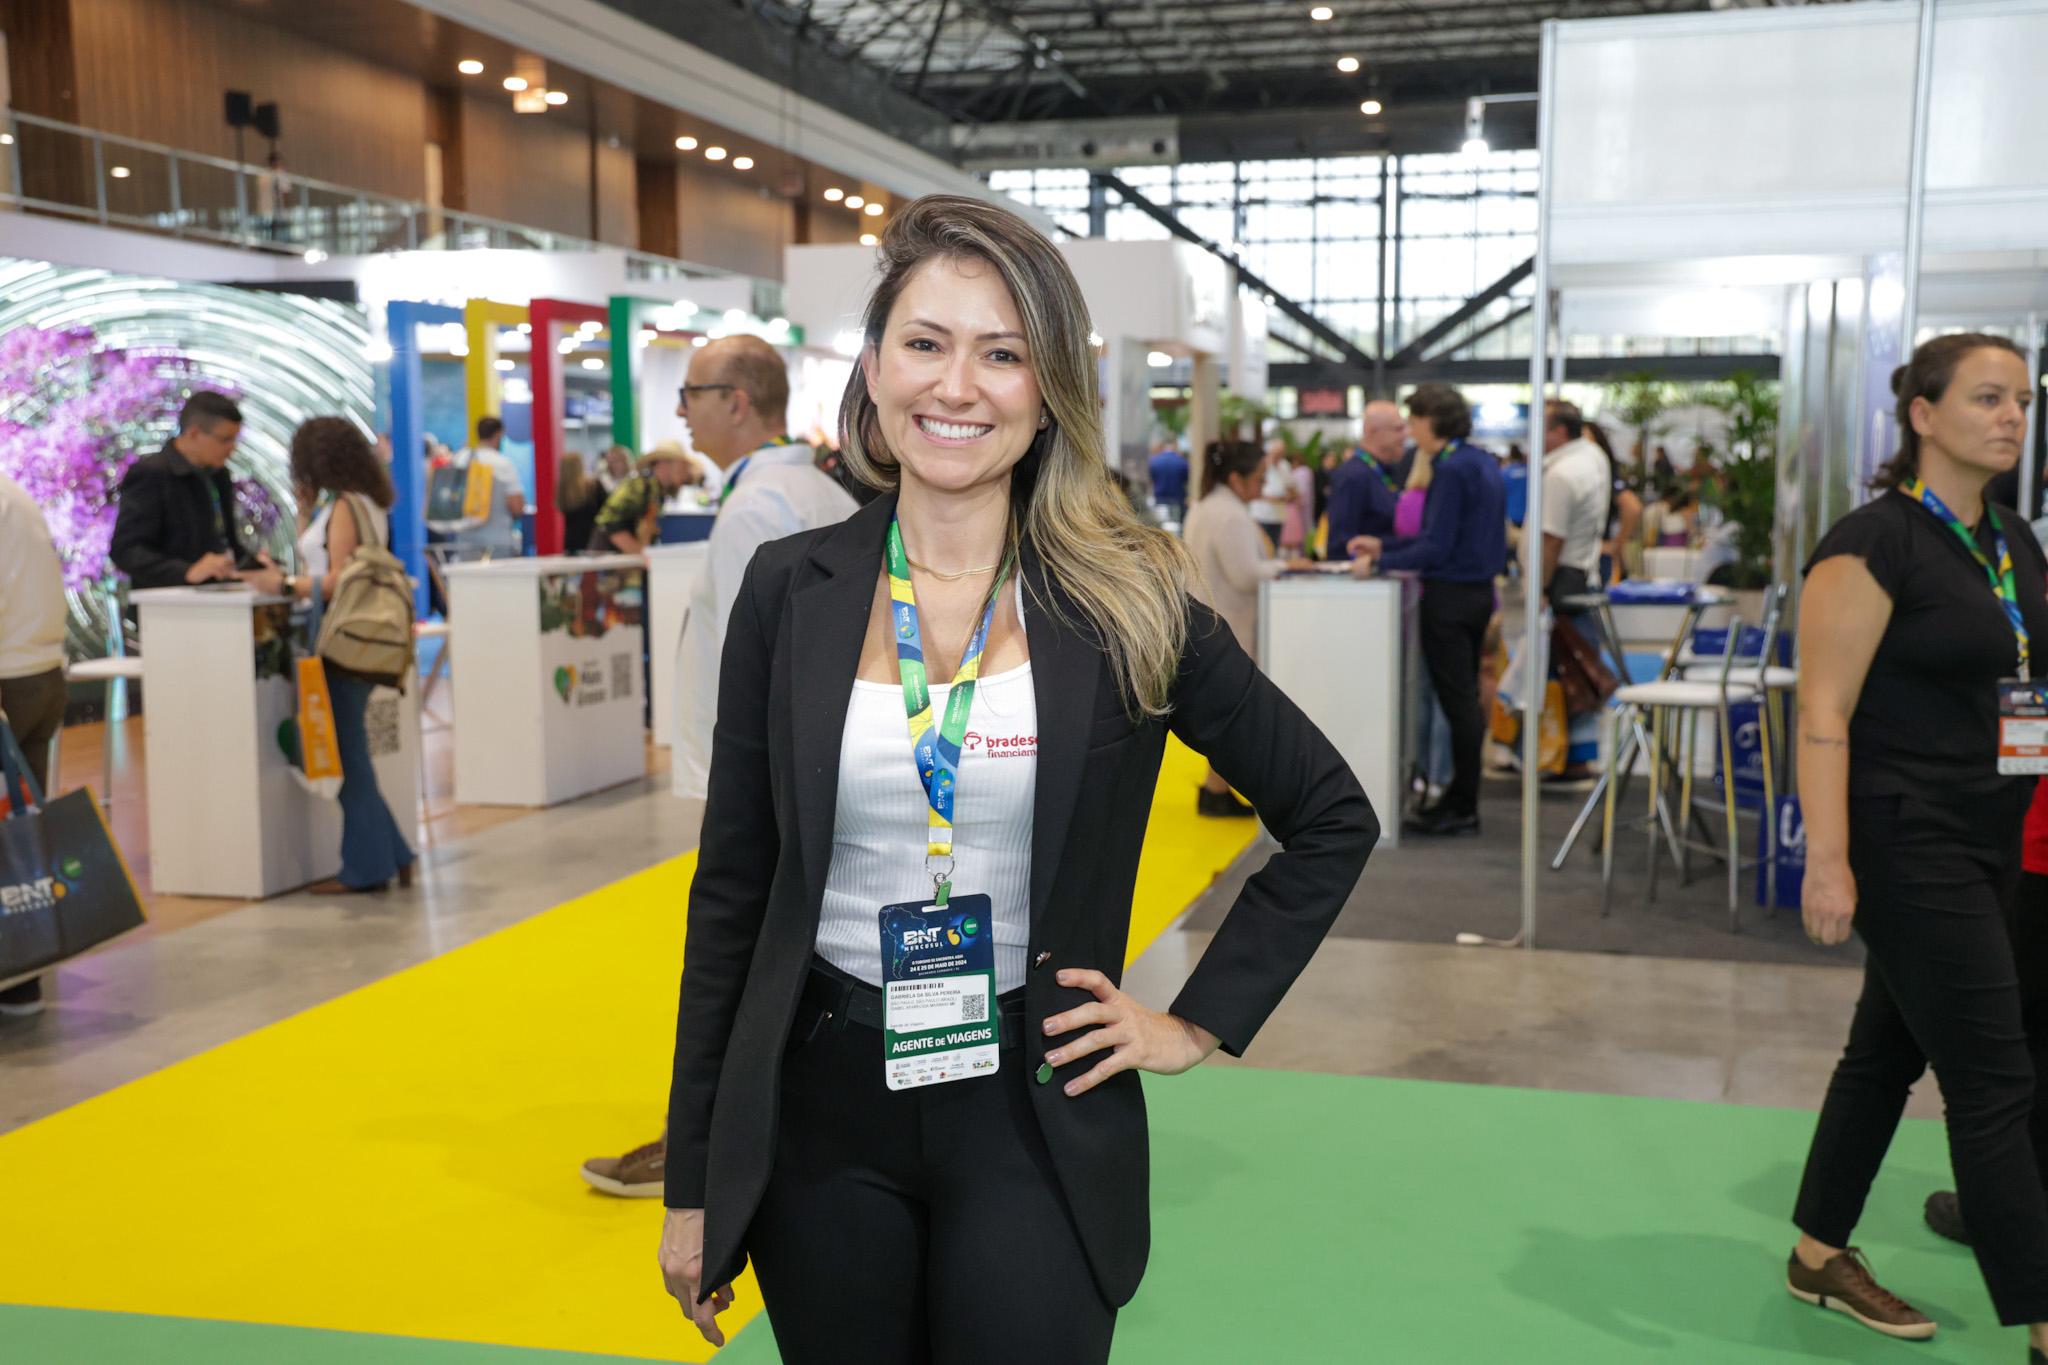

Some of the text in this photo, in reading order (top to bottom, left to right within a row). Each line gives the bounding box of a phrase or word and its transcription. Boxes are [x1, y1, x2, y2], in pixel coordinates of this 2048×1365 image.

[951, 686, 964, 724] machadinho
[923, 746, 934, 766] BNT
[988, 748, 1038, 758] financiam
[903, 927, 942, 946] BNT
[904, 942, 944, 952] MERCOSUL
[892, 1028, 992, 1053] AGENTE DE VIAGENS
